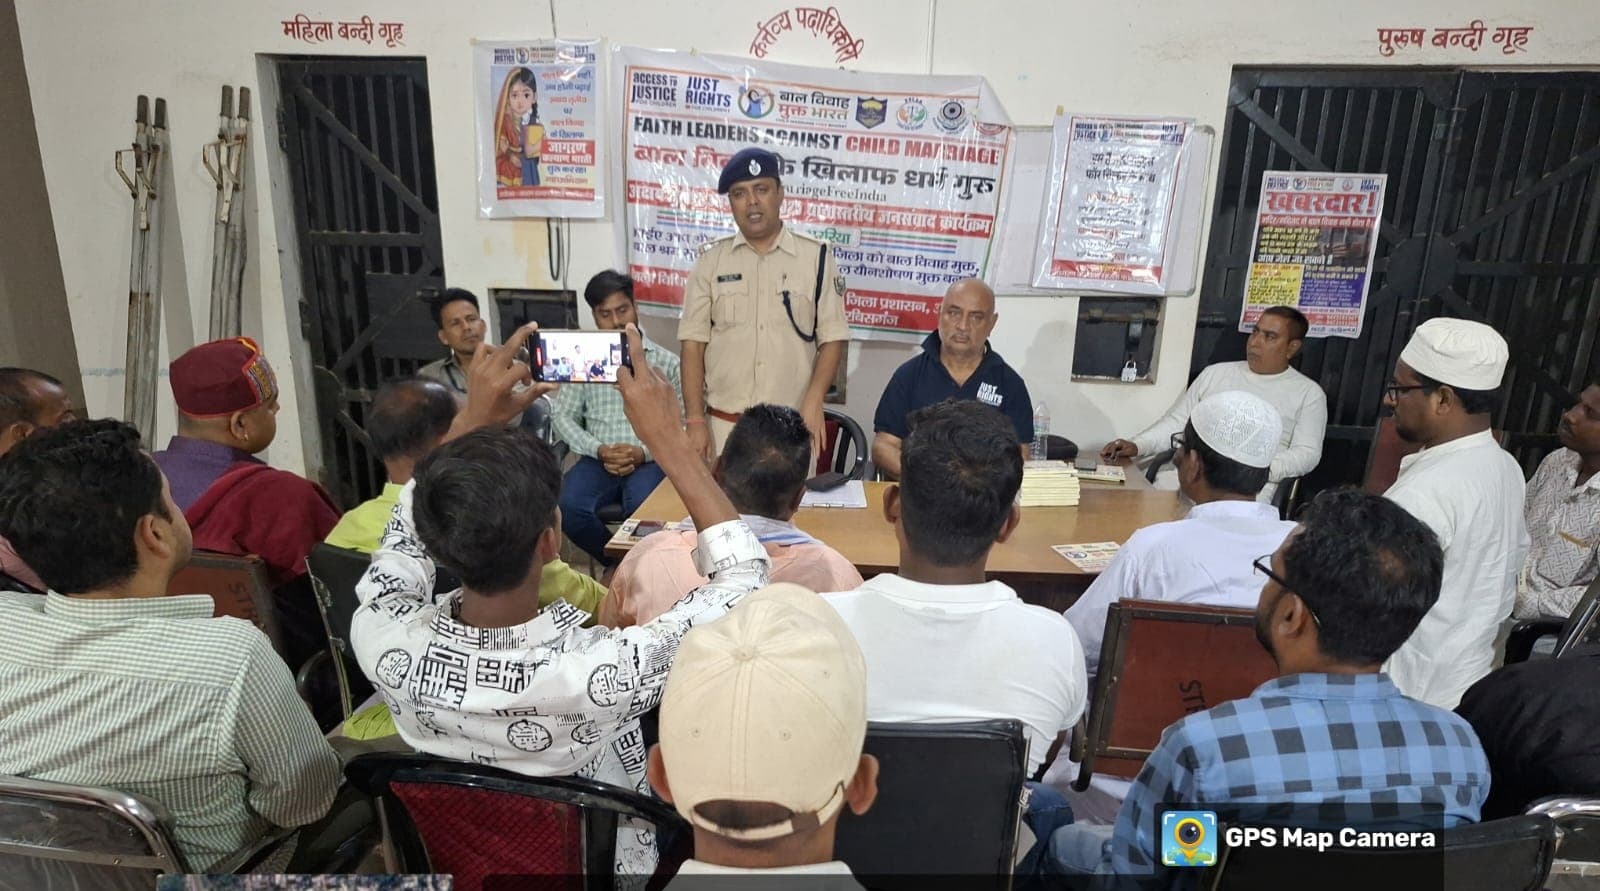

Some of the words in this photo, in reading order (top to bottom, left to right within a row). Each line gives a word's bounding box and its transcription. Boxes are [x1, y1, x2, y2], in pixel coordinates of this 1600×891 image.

[281, 13, 333, 44] महिला
[338, 15, 375, 44] बन्दी
[378, 23, 406, 48] गृह
[795, 6, 865, 63] पदाधिकारी
[1431, 19, 1488, 52] बन्दी
[1492, 26, 1534, 55] गृह
[687, 76, 720, 92] JUST
[631, 85, 677, 104] JUSTICE
[685, 90, 732, 108] RIGHTS
[779, 90, 807, 104] बाल
[810, 92, 850, 109] विवाह
[778, 103, 808, 119] मुक्त
[810, 107, 849, 121] भारत
[634, 116, 682, 137] FAITH
[687, 120, 759, 144] LEADERS
[764, 128, 843, 150] AGAINST
[845, 137, 900, 156] CHILD
[904, 139, 1000, 166] MARRIAGE
[633, 144, 688, 166] बाल
[692, 144, 736, 168] विव
[801, 155, 899, 185] खिलाफ
[904, 167, 949, 190] धर्म
[953, 174, 997, 200] गुरु
[939, 213, 993, 233] कार्यक्रम
[867, 248, 884, 264] को
[886, 253, 912, 266] बाल
[915, 254, 949, 270] विवाह
[853, 262, 913, 281] यौनशोषण
[916, 273, 942, 287] मुक्त
[846, 289, 877, 308] जिला
[845, 311, 899, 326] रबिसगंज
[979, 381, 998, 393] JUST
